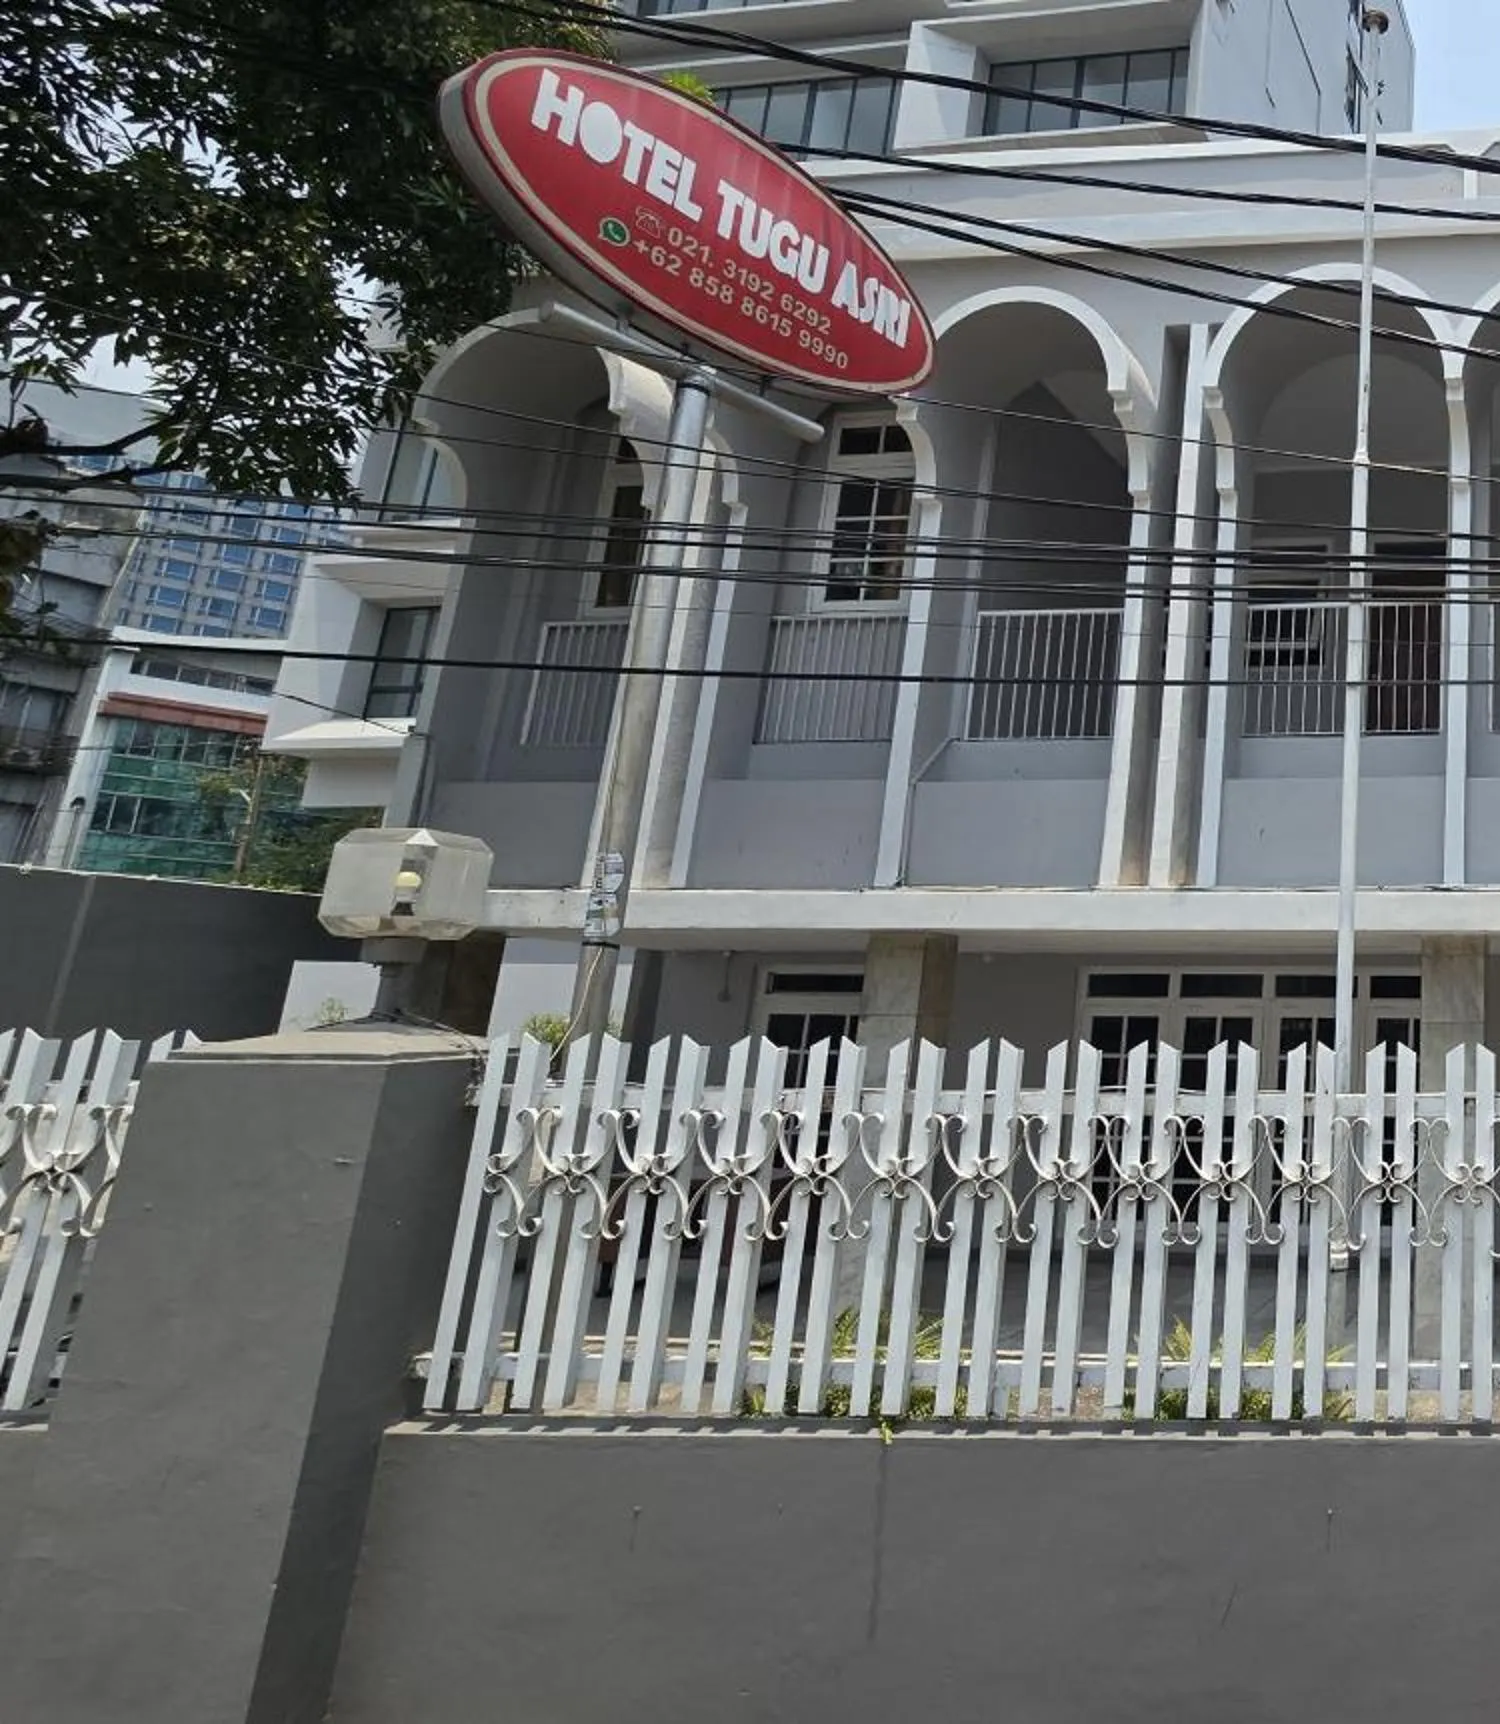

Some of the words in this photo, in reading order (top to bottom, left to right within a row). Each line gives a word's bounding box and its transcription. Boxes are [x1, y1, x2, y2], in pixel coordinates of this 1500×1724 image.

[531, 67, 703, 223] HOTEL
[717, 179, 830, 294] TUGU
[831, 260, 911, 348] ASRI
[632, 239, 683, 277] +62
[689, 267, 734, 305] 858
[740, 297, 793, 338] 8615
[799, 329, 849, 370] 9990
[667, 227, 714, 268] 021.
[722, 258, 775, 301] 3192
[780, 293, 832, 335] 6292
